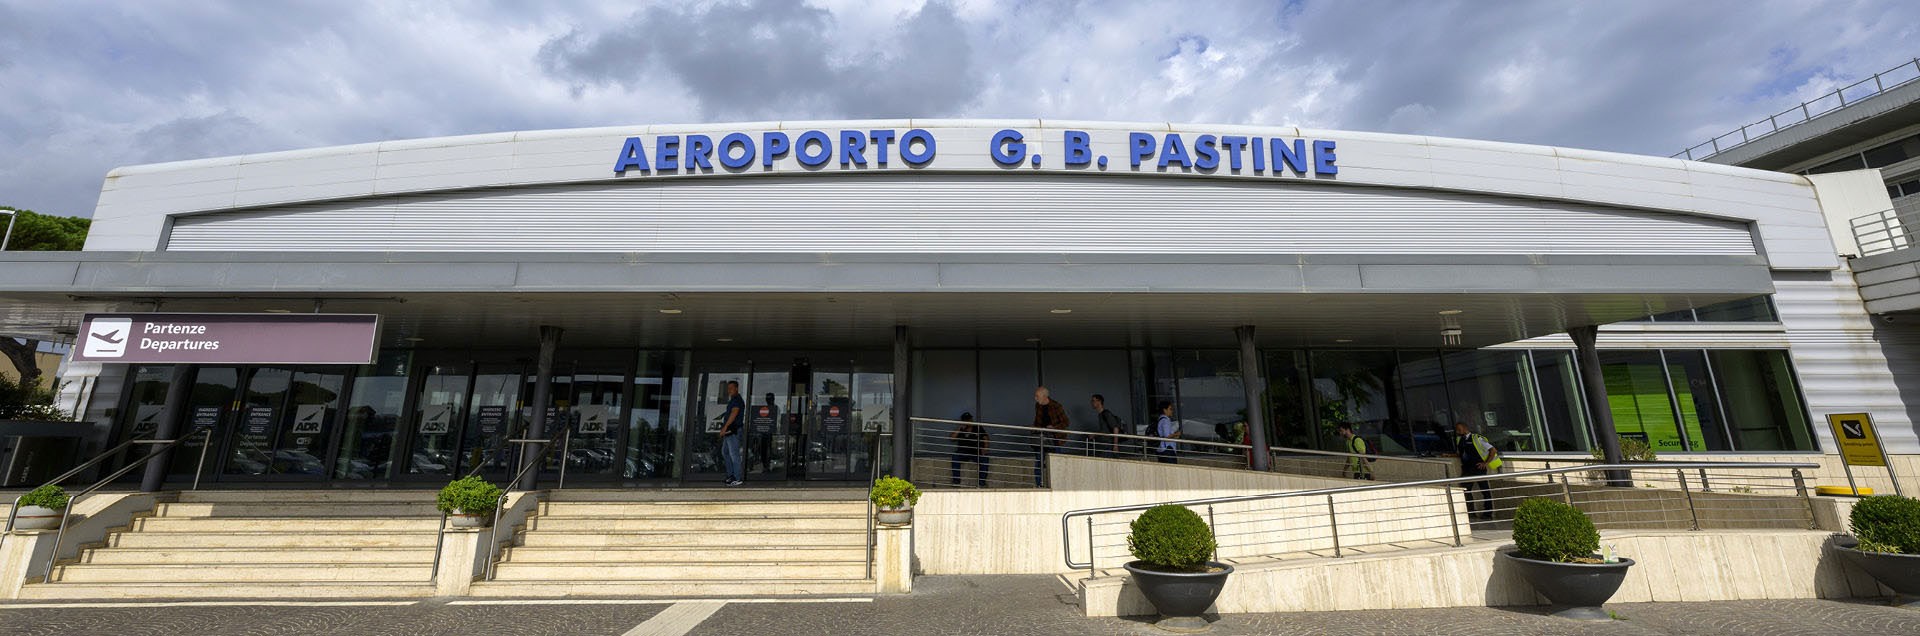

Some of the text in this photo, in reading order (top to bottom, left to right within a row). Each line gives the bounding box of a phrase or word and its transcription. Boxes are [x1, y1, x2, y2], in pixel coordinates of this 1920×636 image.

[614, 129, 1339, 176] AEROPORTO G. B. PASTINE
[143, 322, 207, 335] Partenze
[139, 337, 220, 353] Departures
[295, 422, 319, 432] ADR
[422, 422, 446, 432] ADR
[581, 422, 605, 432] ADR
[708, 421, 722, 431] AD
